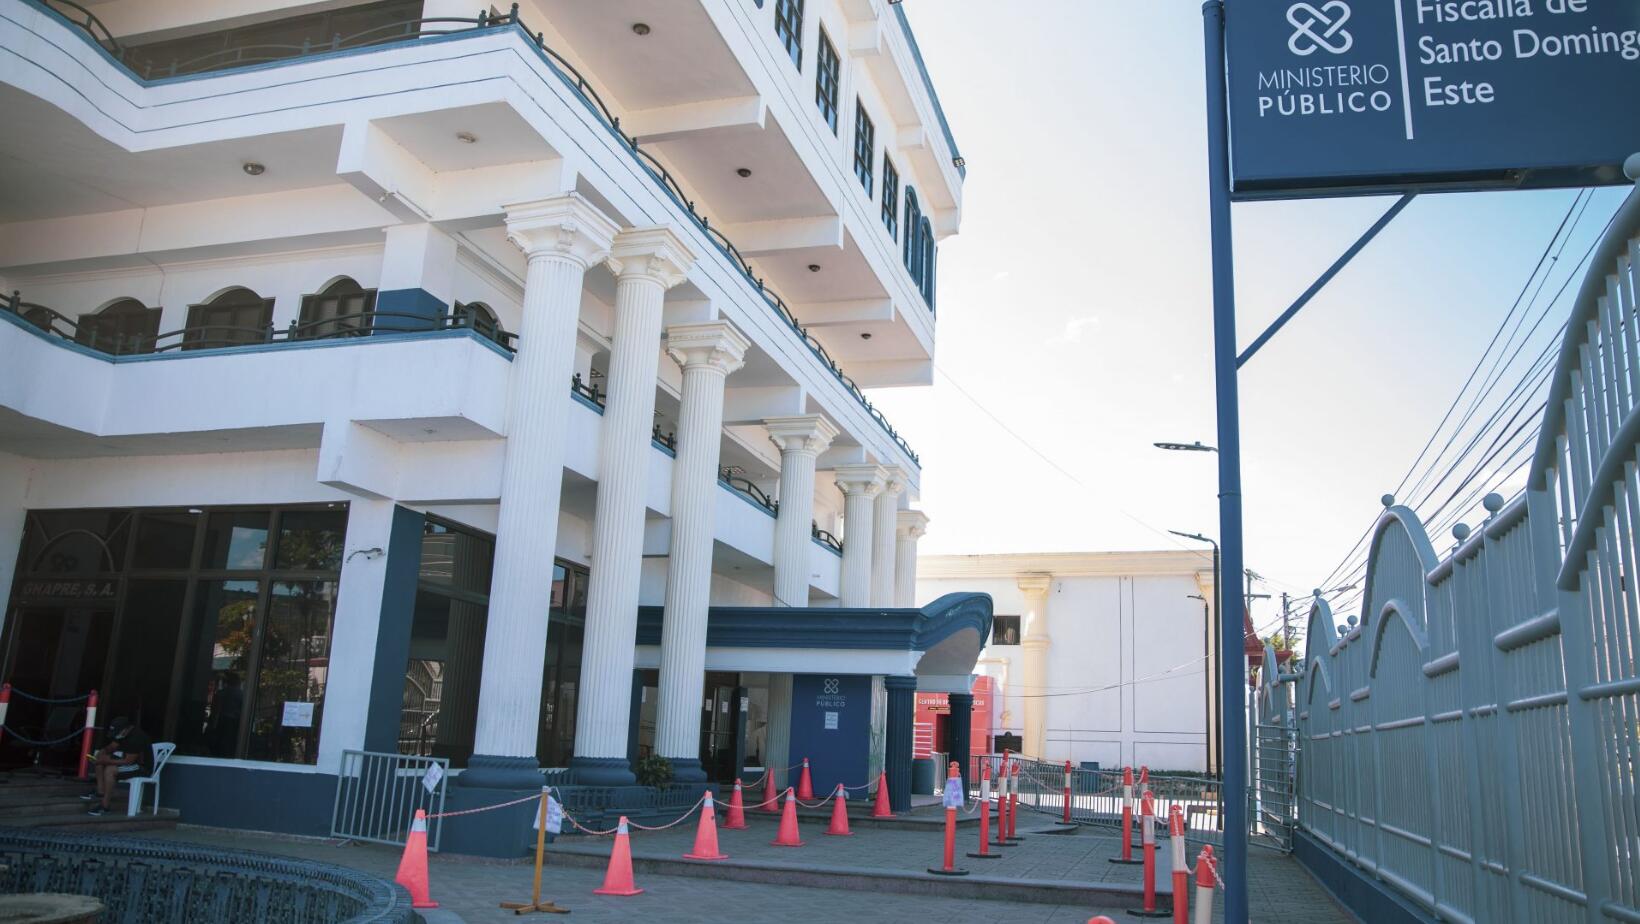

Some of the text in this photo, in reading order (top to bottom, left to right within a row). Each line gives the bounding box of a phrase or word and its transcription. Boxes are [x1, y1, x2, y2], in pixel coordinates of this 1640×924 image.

[1418, 26, 1640, 65] Santo Doming
[1258, 63, 1389, 91] MINISTERIO
[1423, 76, 1495, 106] Este
[1258, 90, 1392, 117] PÚBLICO
